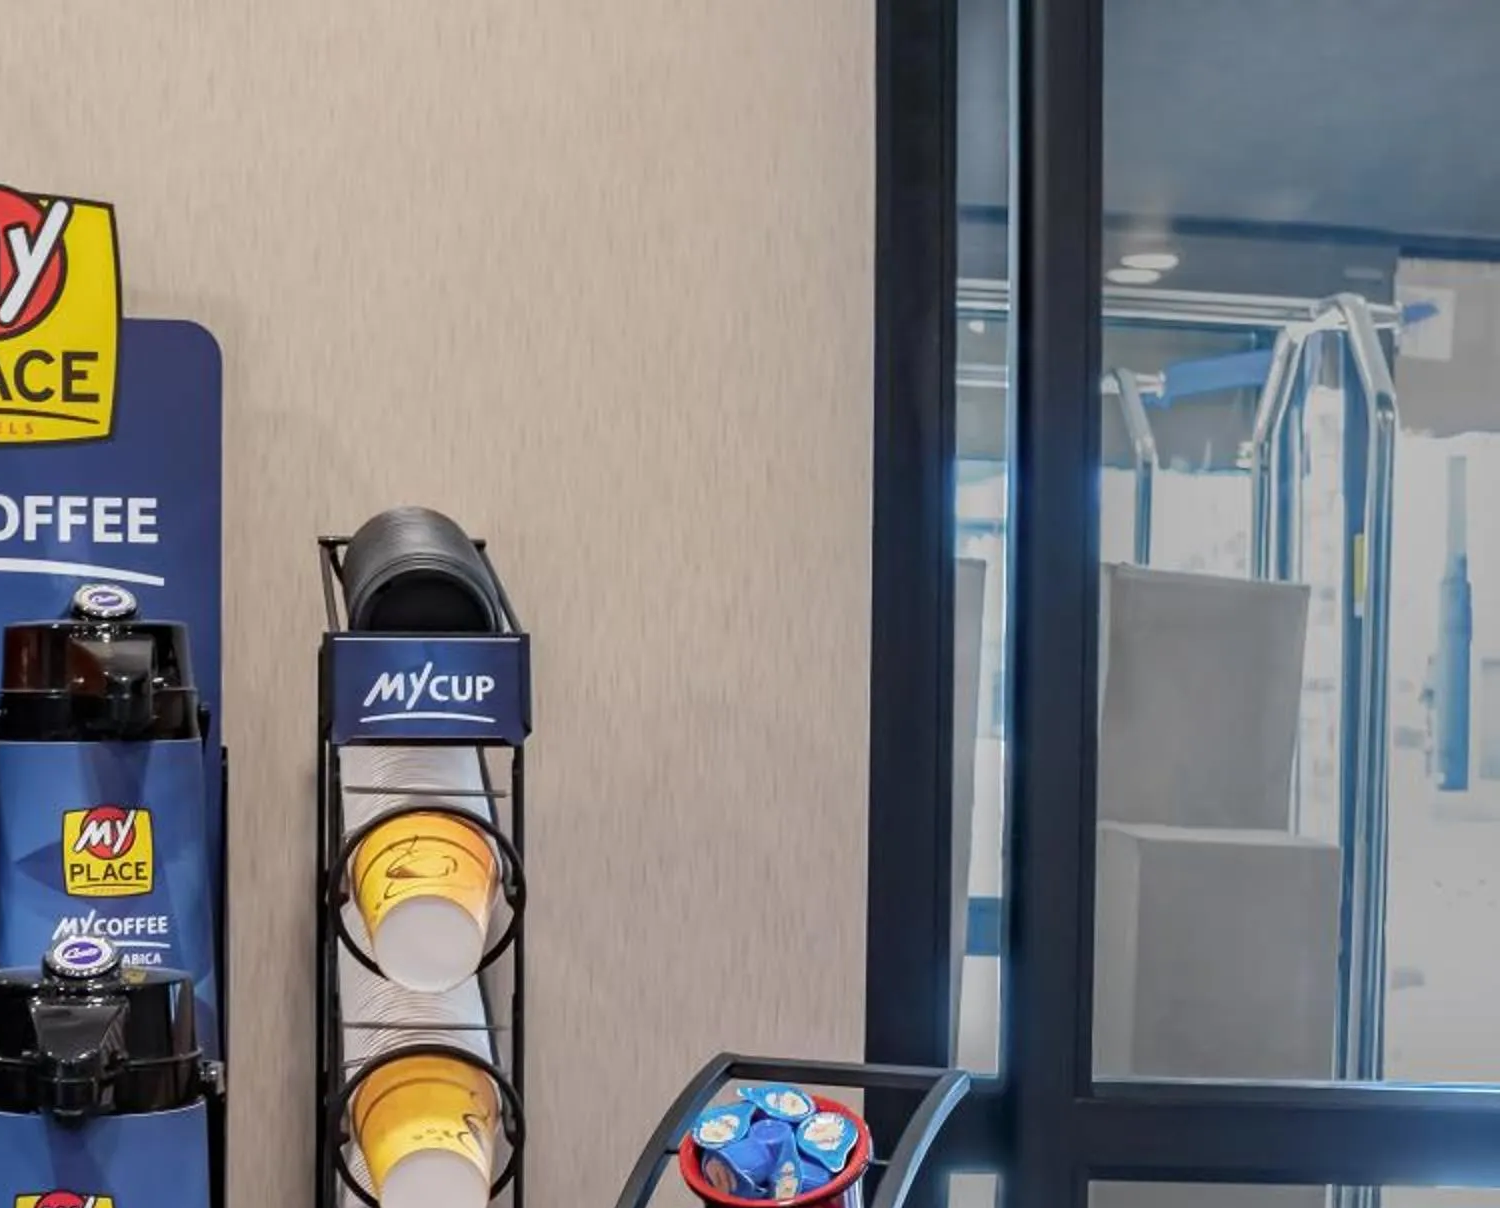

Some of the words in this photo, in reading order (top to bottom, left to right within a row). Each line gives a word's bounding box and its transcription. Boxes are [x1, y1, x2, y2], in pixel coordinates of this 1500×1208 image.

[74, 809, 138, 855] MY
[69, 861, 149, 882] PLACE
[121, 952, 162, 966] ABICA
